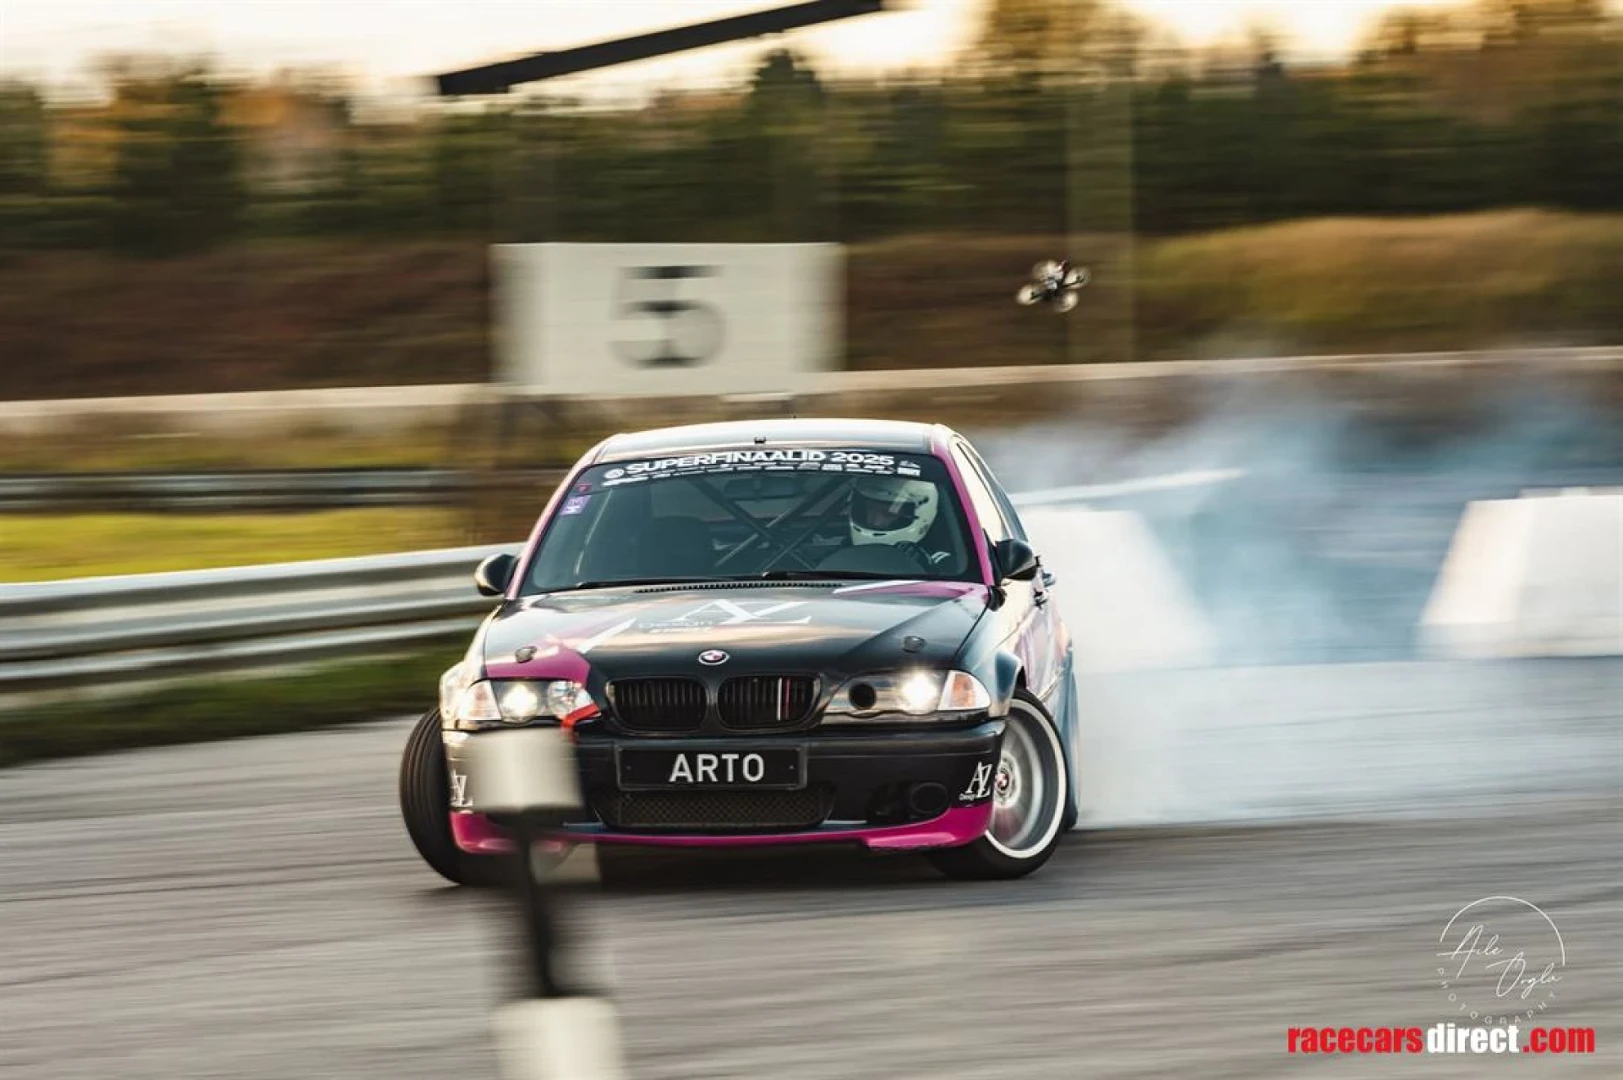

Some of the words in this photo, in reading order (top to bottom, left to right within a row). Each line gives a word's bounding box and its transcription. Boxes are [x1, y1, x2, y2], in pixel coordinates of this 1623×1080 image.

[608, 265, 731, 370] 5
[625, 450, 826, 474] SUPERFINAALID
[830, 452, 895, 466] 2025
[669, 753, 764, 783] ARTO
